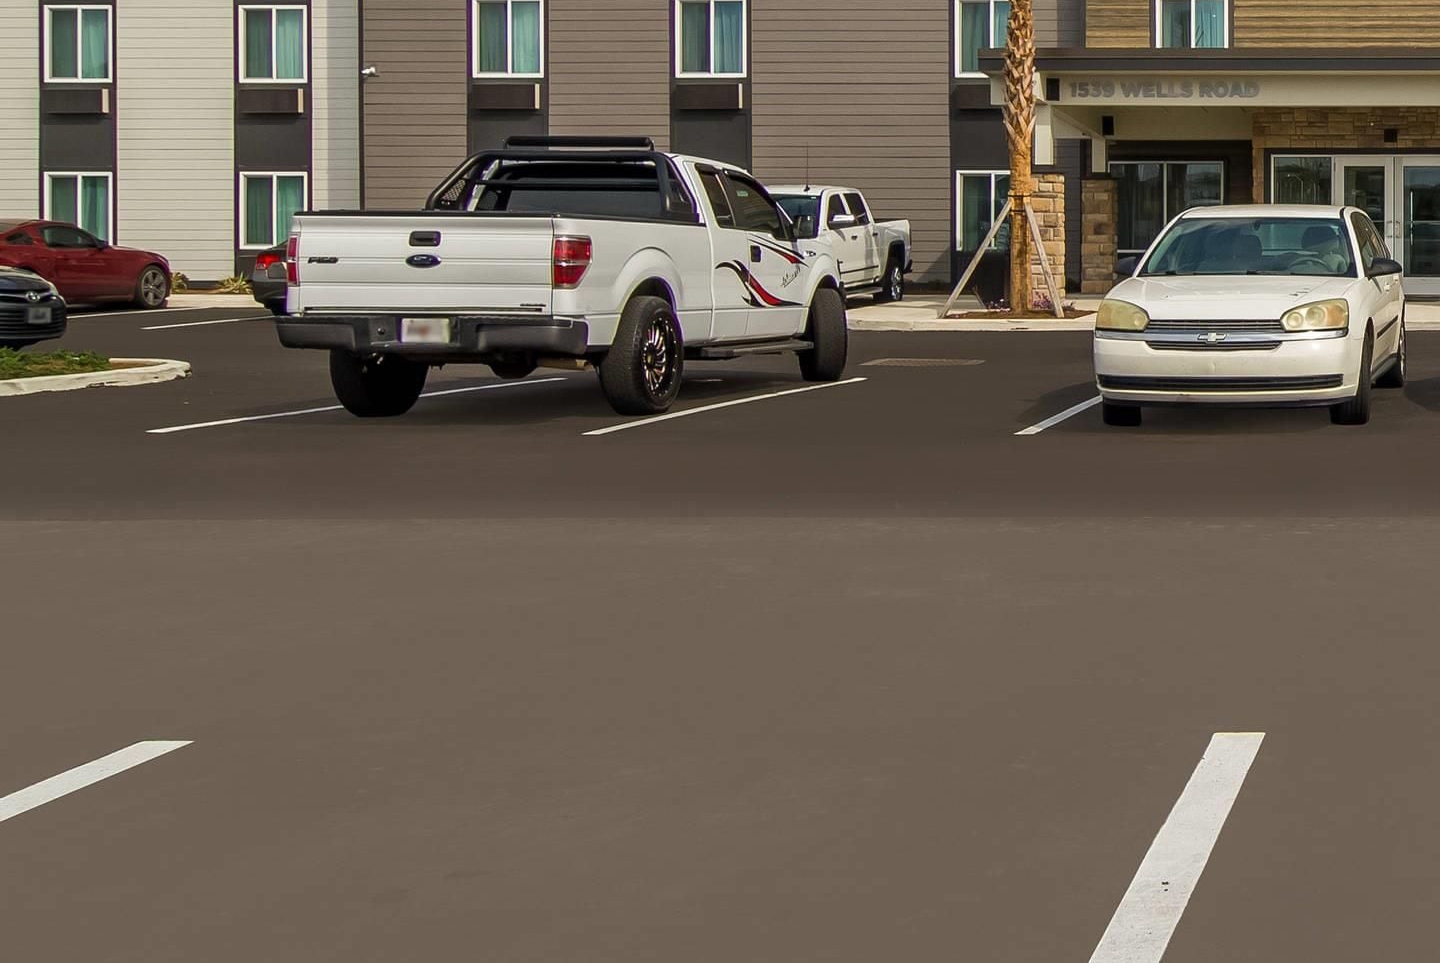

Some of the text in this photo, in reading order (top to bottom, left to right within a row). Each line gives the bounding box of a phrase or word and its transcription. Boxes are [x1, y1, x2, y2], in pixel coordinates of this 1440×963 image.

[1070, 81, 1260, 98] 1539 WELLS ROAD
